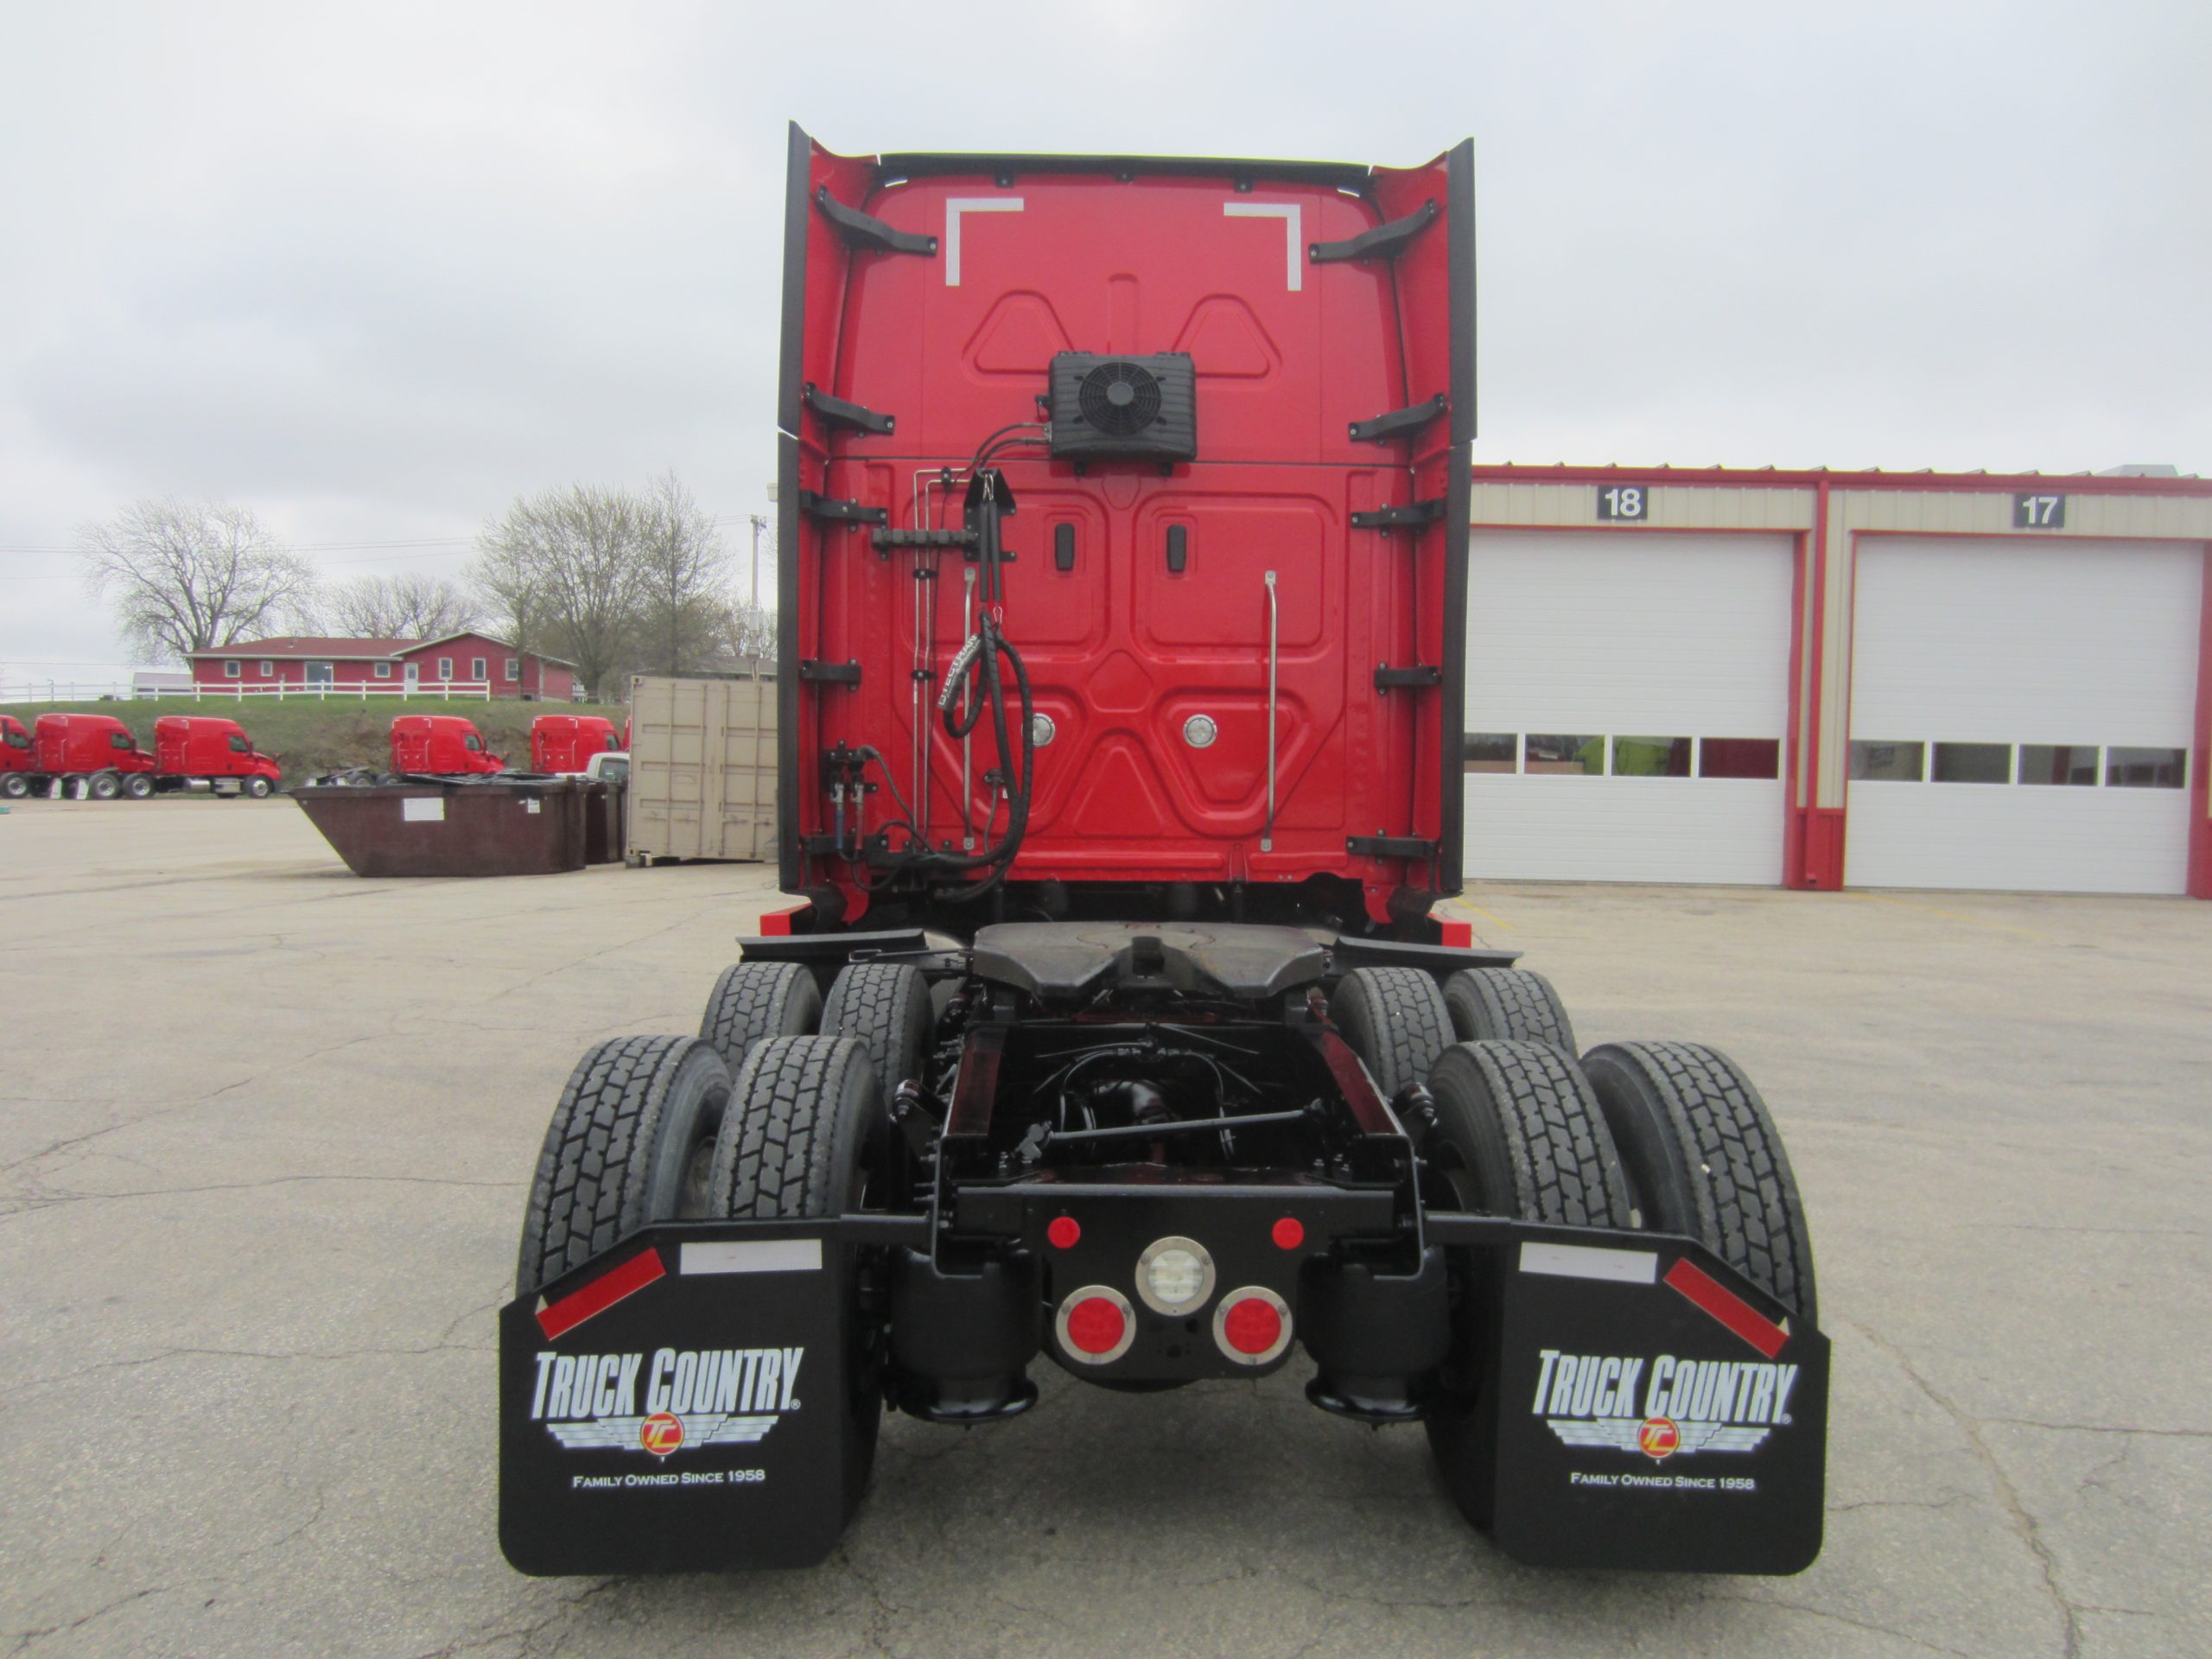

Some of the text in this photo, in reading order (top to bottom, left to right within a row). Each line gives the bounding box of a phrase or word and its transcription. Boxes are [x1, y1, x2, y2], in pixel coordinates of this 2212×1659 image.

[1605, 488, 1641, 517] 18
[2022, 496, 2058, 524] 17
[531, 1347, 804, 1419] TRUCK COUNTRY
[1532, 1350, 1798, 1424] TRUCK COUNTRY
[572, 1469, 766, 1488] FAMILY OWNED SINCE 1958
[1570, 1471, 1755, 1490] FAMILY OWNED SINCE 1958
